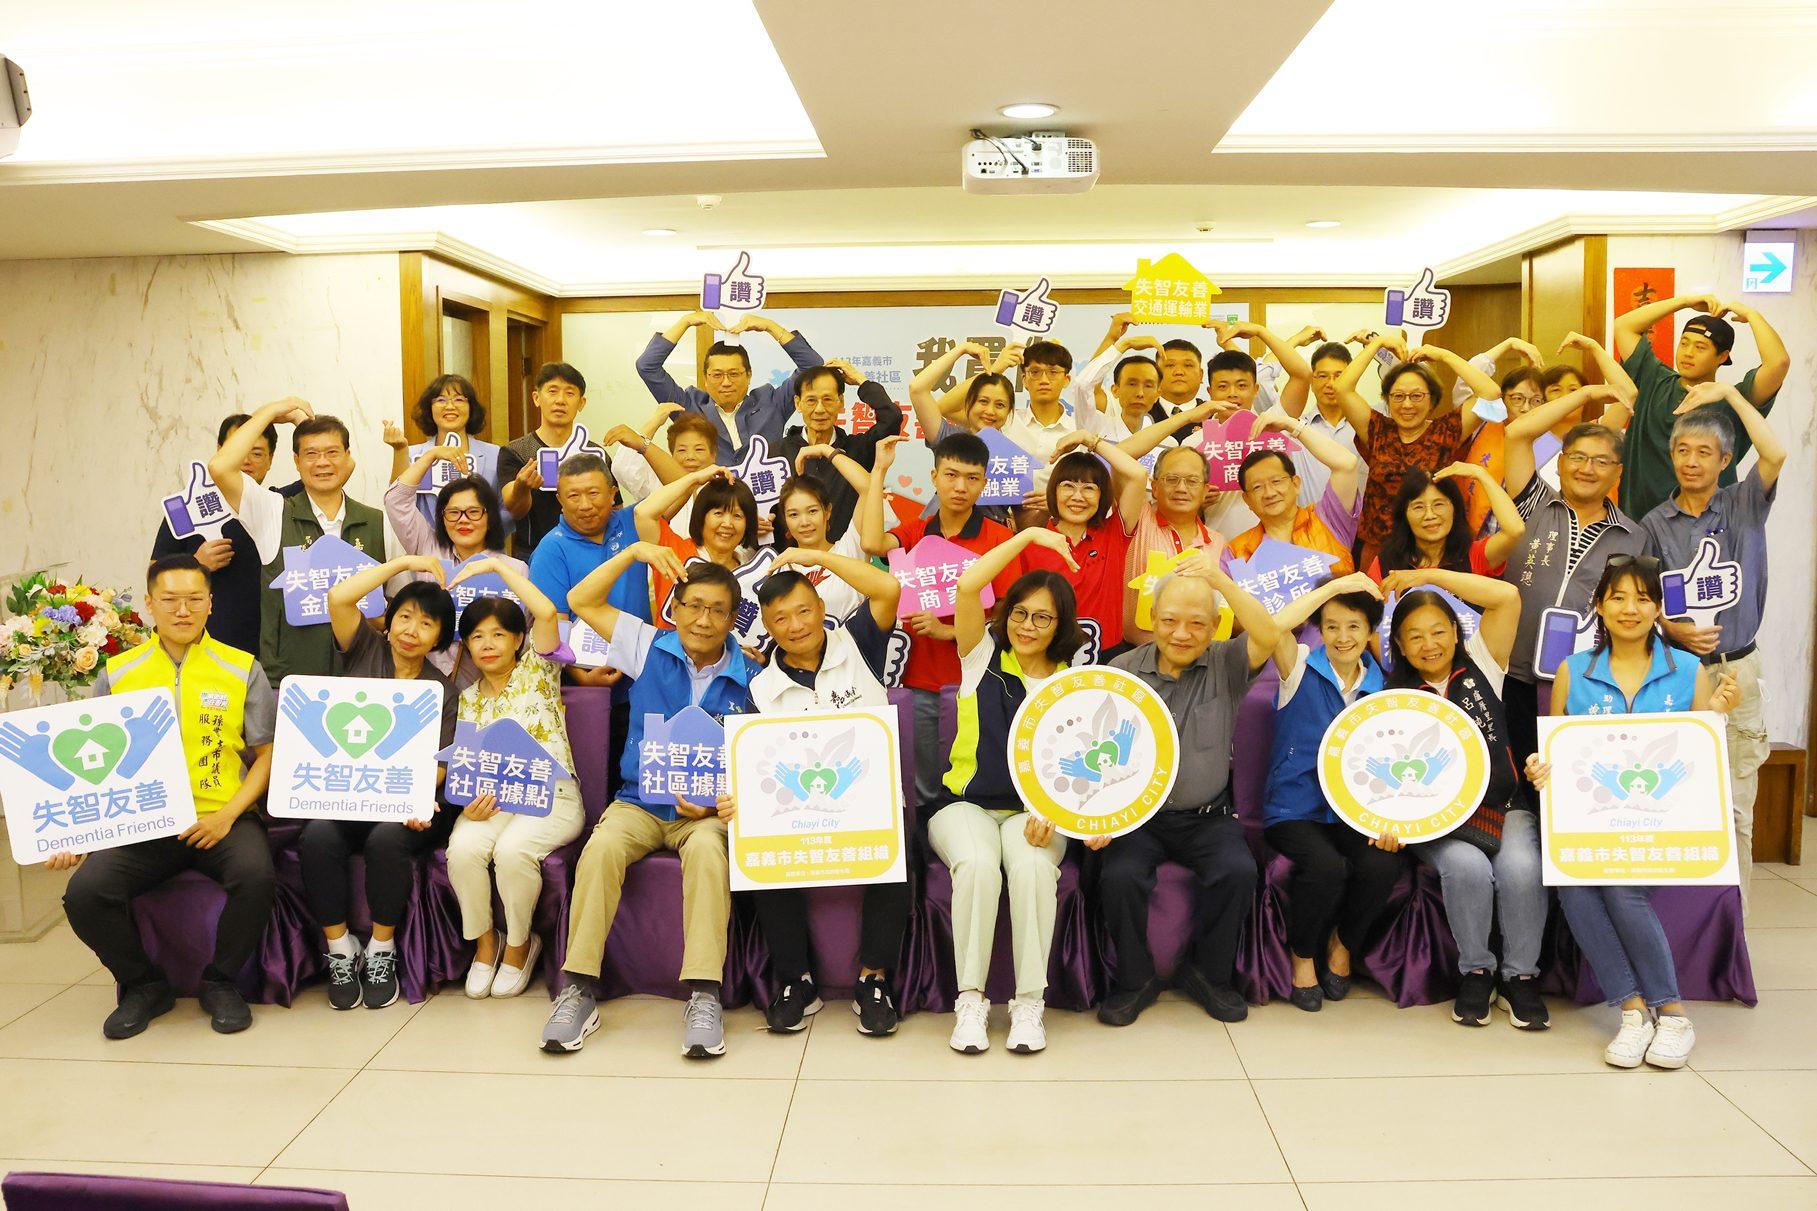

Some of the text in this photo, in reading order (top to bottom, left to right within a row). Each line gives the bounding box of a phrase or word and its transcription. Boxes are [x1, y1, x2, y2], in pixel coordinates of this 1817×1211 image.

[730, 281, 752, 303] 讚
[1135, 278, 1209, 299] 失智友善
[1022, 303, 1044, 327] 讚
[1134, 299, 1207, 319] 交通運輸業
[1412, 297, 1436, 320] 讚
[750, 472, 777, 494] 讚
[195, 491, 224, 518] 讚
[1697, 575, 1723, 601] 讚
[452, 745, 552, 782] 失智友善
[292, 762, 414, 795] 失智友善
[449, 771, 550, 809] 社區據點
[33, 779, 168, 834] 失智友善
[289, 796, 414, 814] Dementia Friends
[1076, 766, 1168, 830] CHIAYI CITY
[791, 818, 840, 830] Chiayi City
[1358, 799, 1467, 834] CHIAYI CITY
[1609, 817, 1663, 828] Chiayi City
[37, 815, 175, 853] Dementia Friends
[744, 845, 890, 868] 嘉義市失智友善組織
